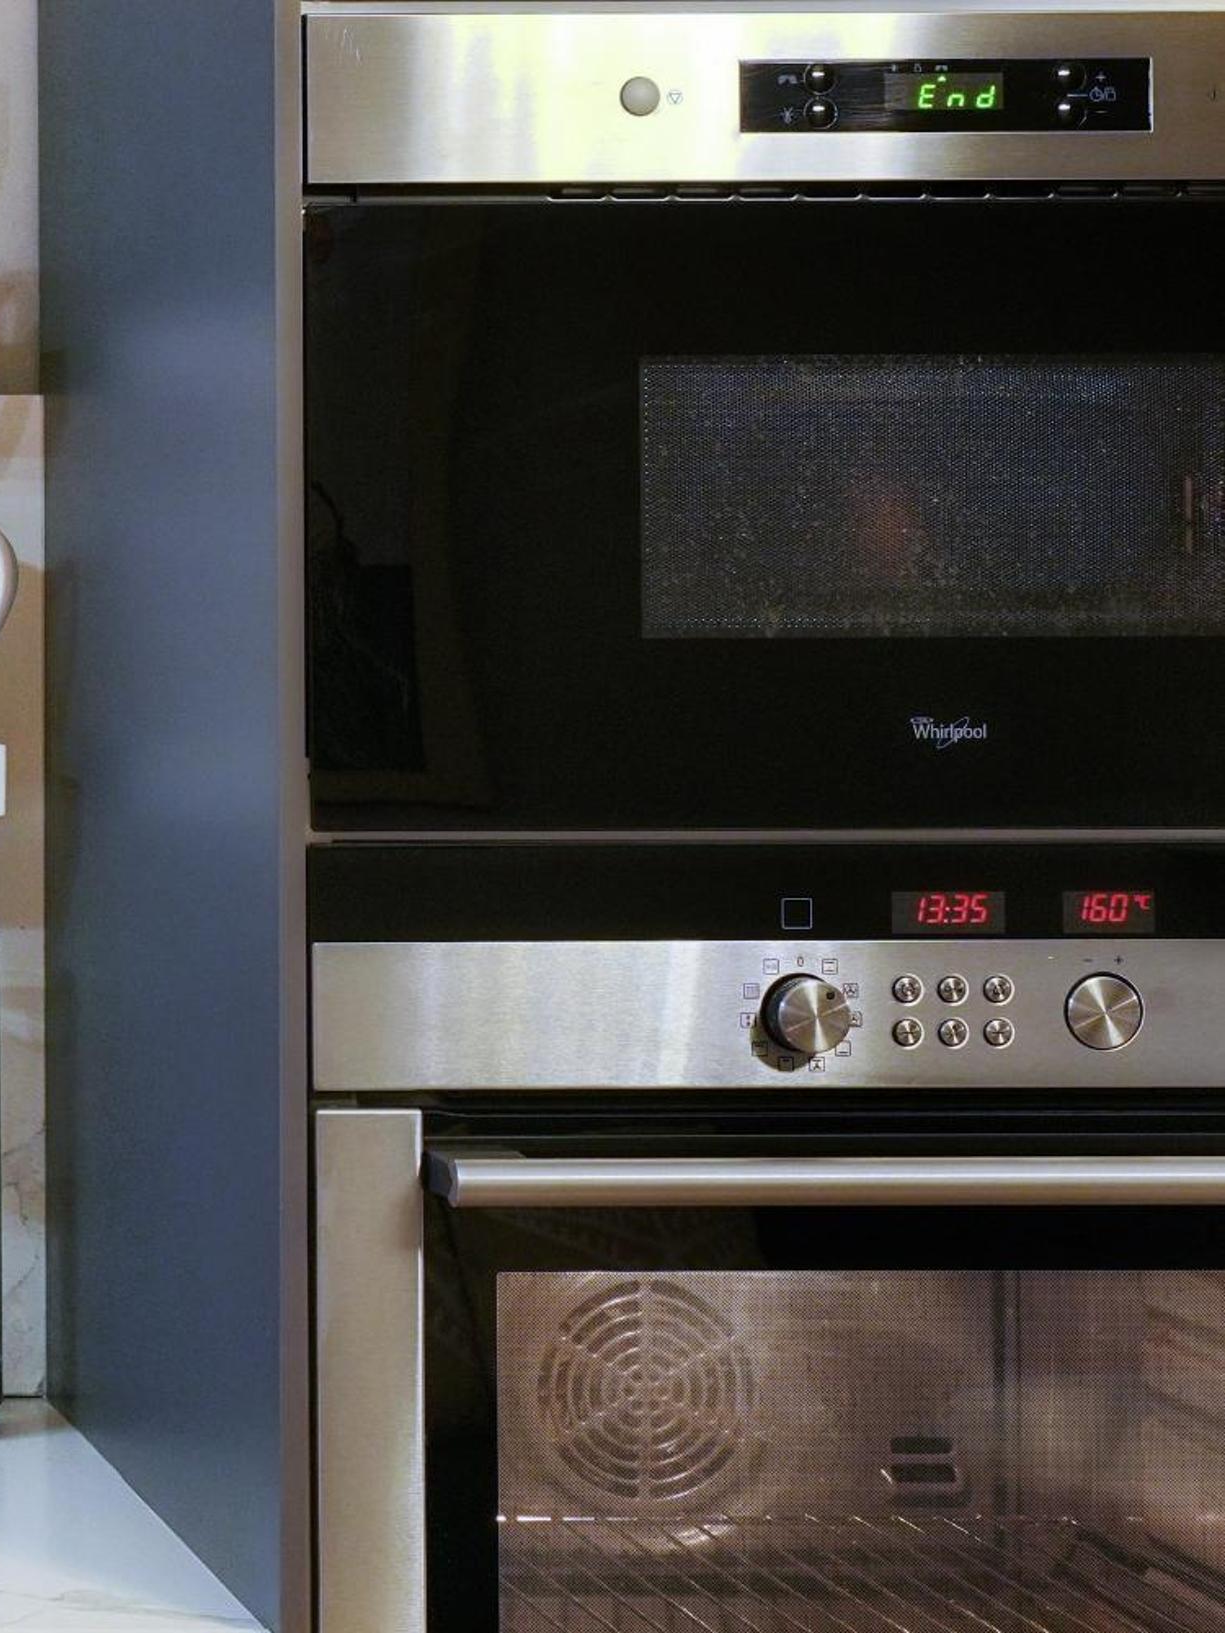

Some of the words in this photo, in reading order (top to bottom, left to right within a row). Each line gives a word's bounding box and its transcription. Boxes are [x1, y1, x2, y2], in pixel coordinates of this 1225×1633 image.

[918, 84, 996, 109] End
[912, 721, 988, 745] Whirlpool
[917, 893, 989, 924] 13:35
